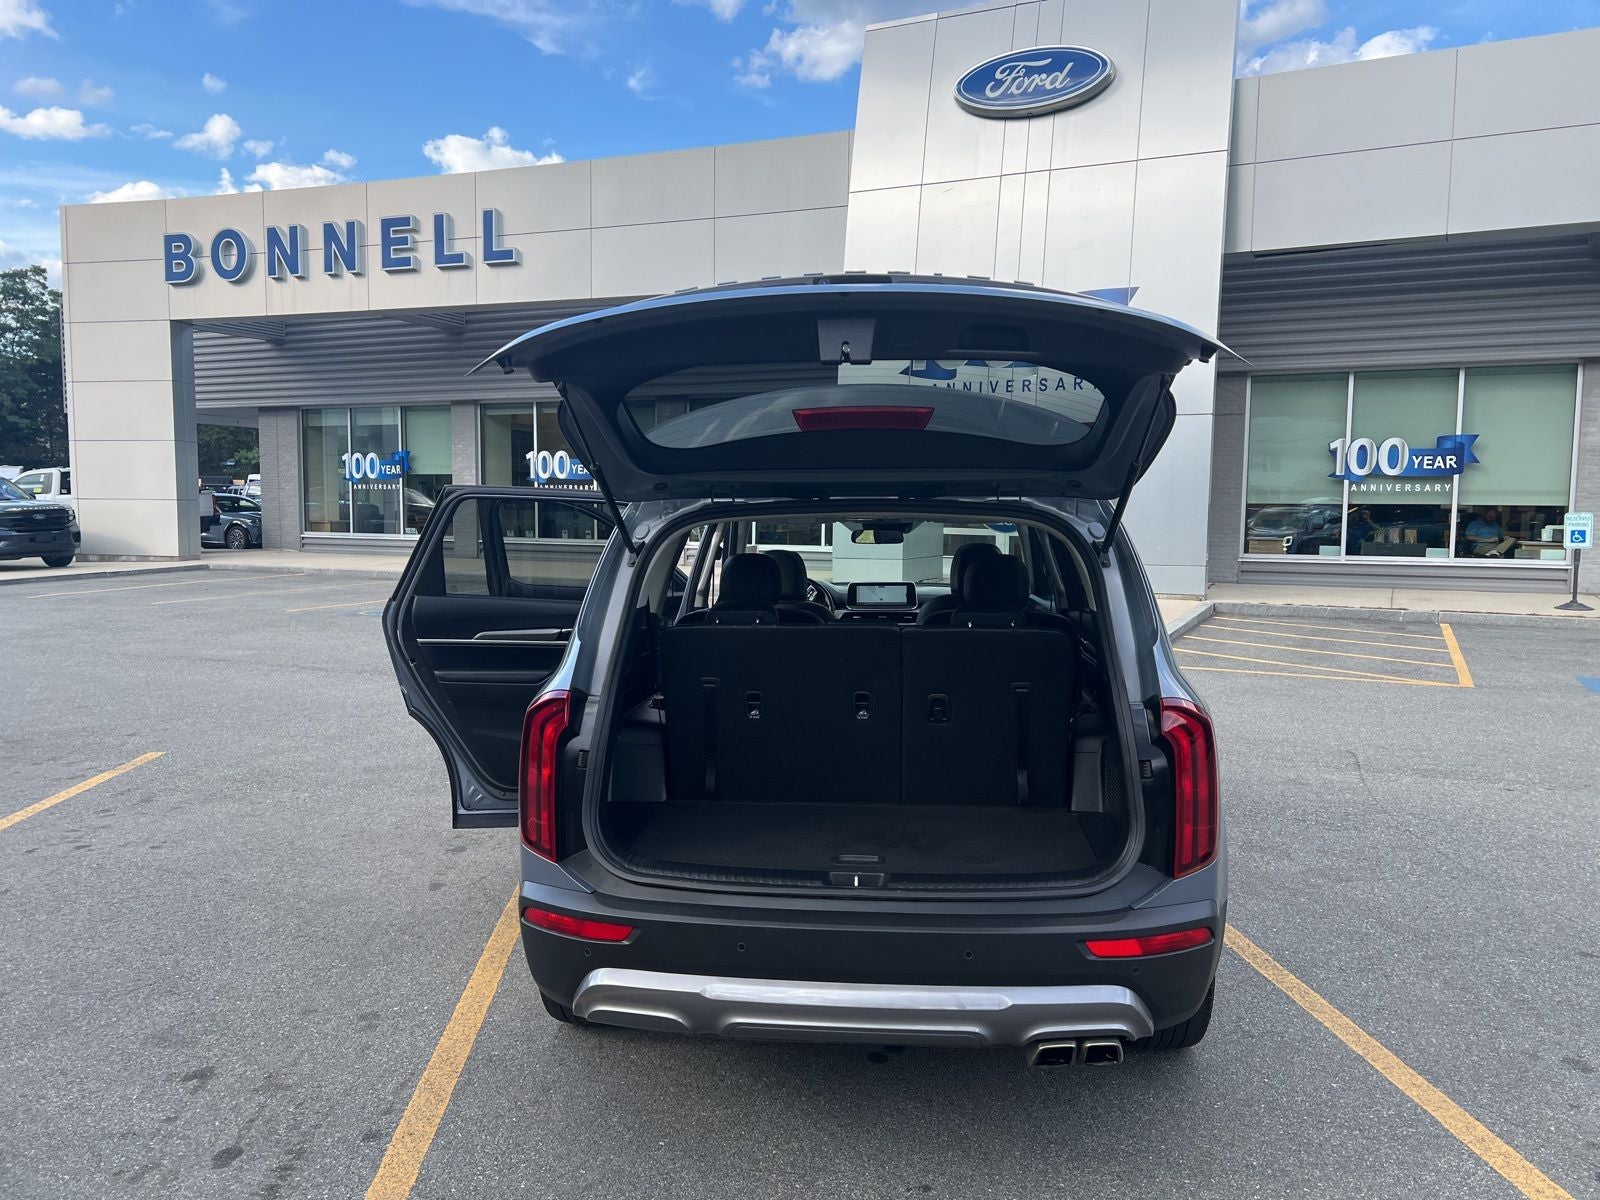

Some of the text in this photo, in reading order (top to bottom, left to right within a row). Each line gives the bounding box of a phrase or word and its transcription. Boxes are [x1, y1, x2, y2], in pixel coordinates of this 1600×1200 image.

[985, 58, 1074, 98] Ford
[163, 207, 521, 287] BONNELL
[341, 452, 402, 479] 100 YEAR
[525, 450, 571, 479] 100
[1329, 437, 1458, 476] 100 YEAR
[1350, 483, 1451, 492] ANNIVERSARY
